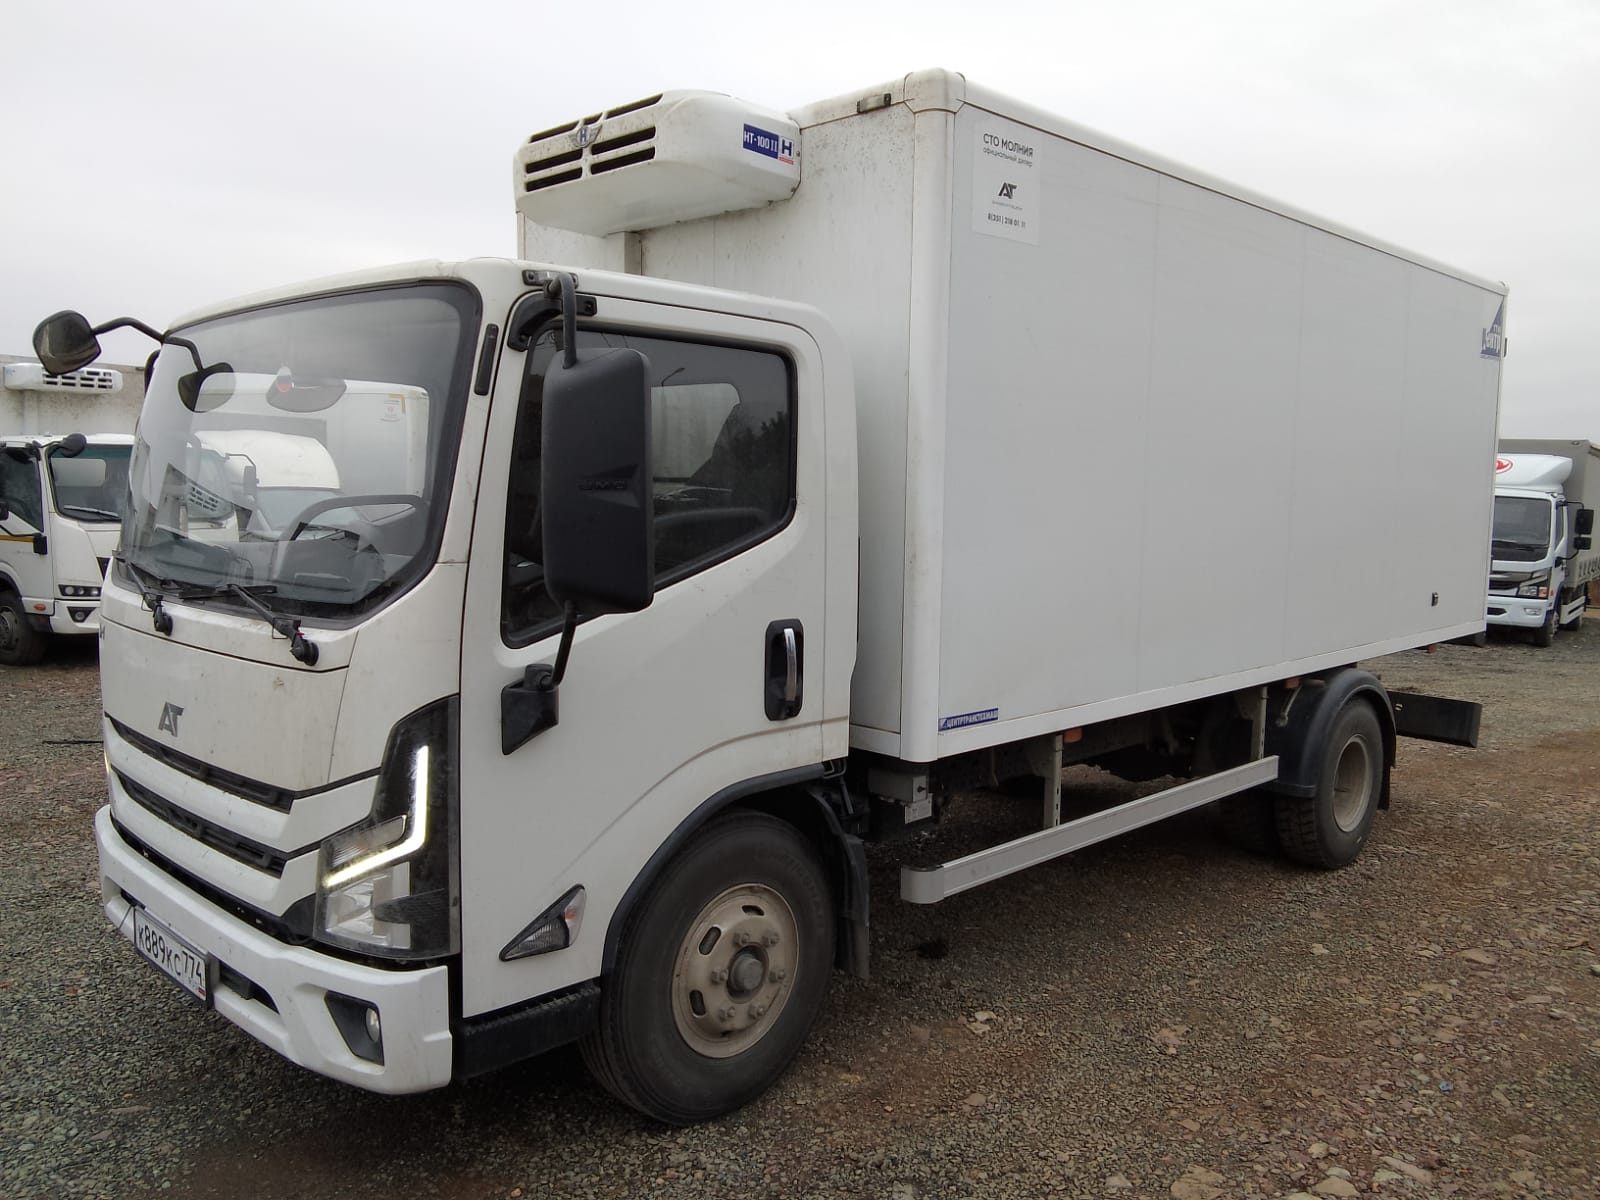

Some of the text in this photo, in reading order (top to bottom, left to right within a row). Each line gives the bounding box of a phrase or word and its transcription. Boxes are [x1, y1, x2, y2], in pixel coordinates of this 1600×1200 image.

[744, 130, 770, 149] HT-100
[782, 139, 792, 156] H
[983, 133, 1034, 158] СТО МОЛНИЯ
